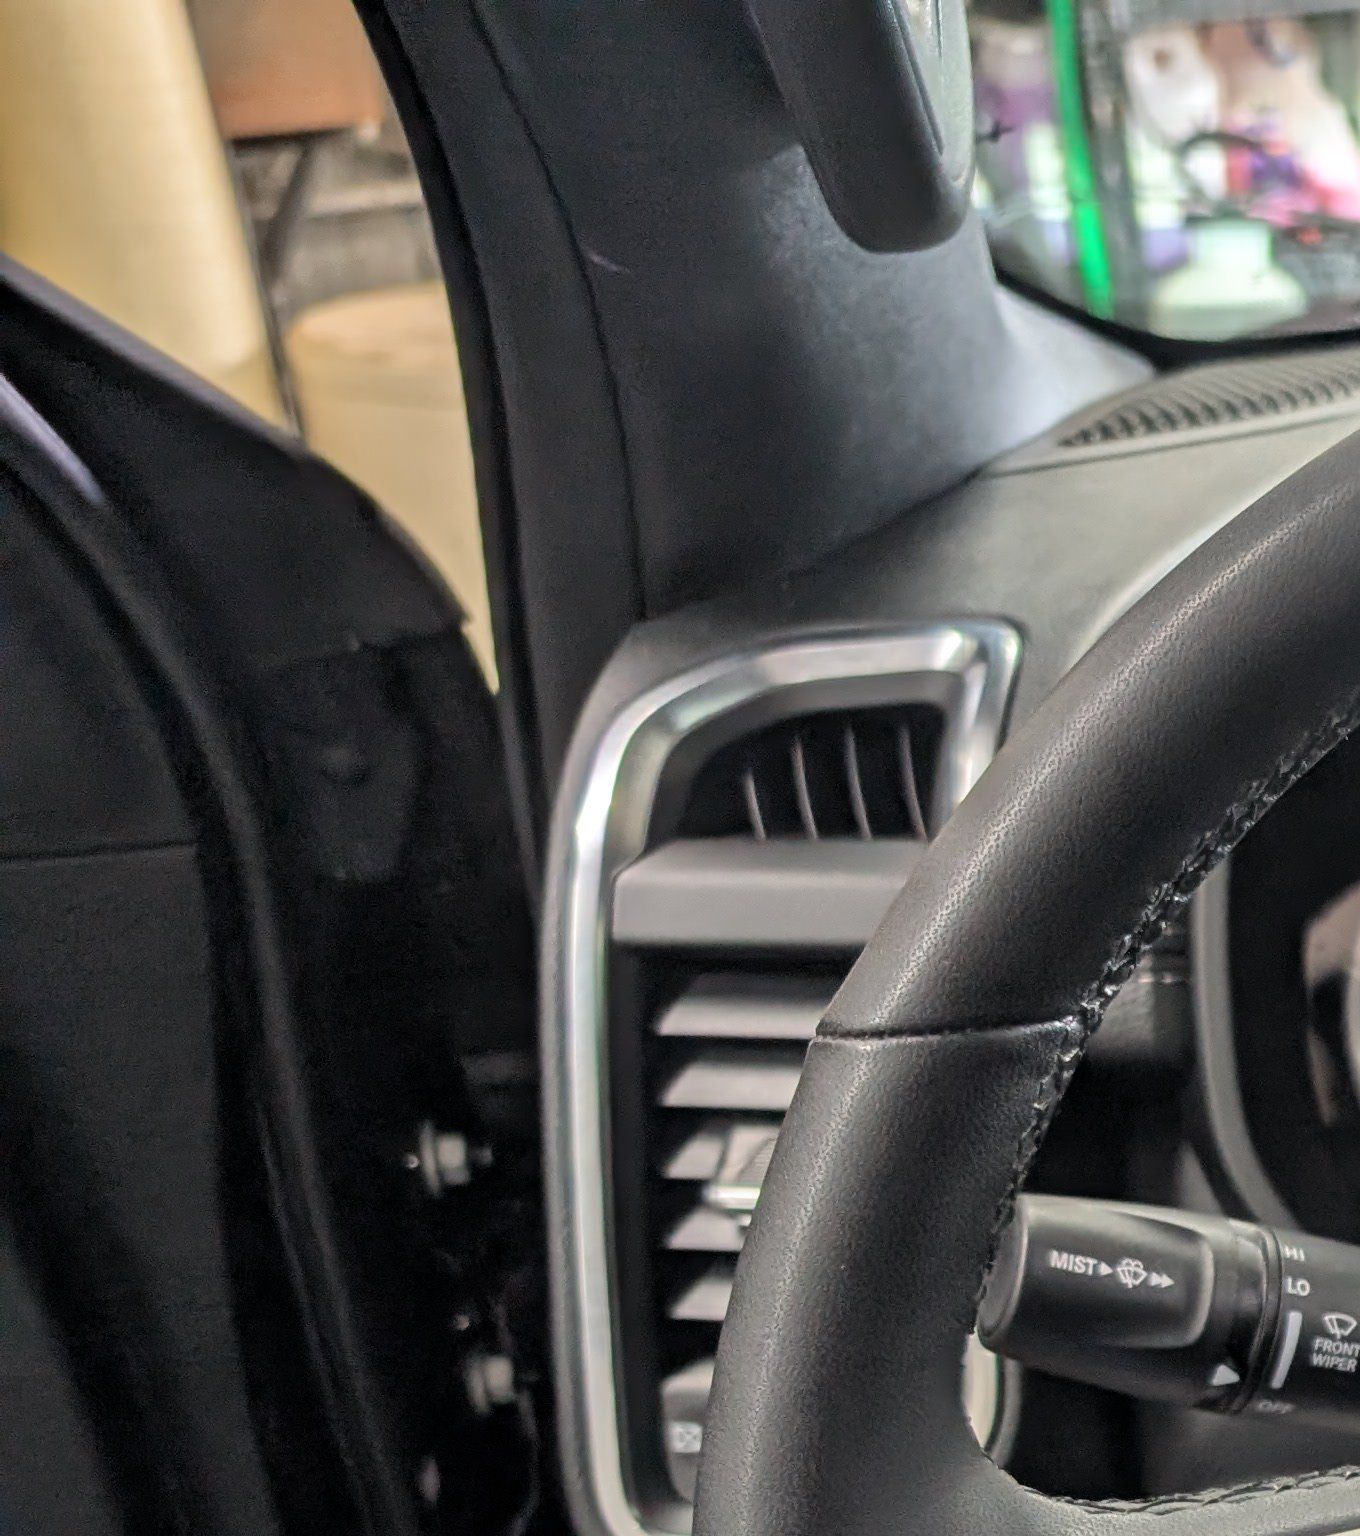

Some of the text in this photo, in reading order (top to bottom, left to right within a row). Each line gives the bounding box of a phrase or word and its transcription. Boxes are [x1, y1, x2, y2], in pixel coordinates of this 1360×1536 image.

[1048, 1249, 1098, 1276] MIST
[1283, 1245, 1305, 1262] HI
[1287, 1276, 1311, 1297] LO
[1312, 1353, 1358, 1373] WIPER
